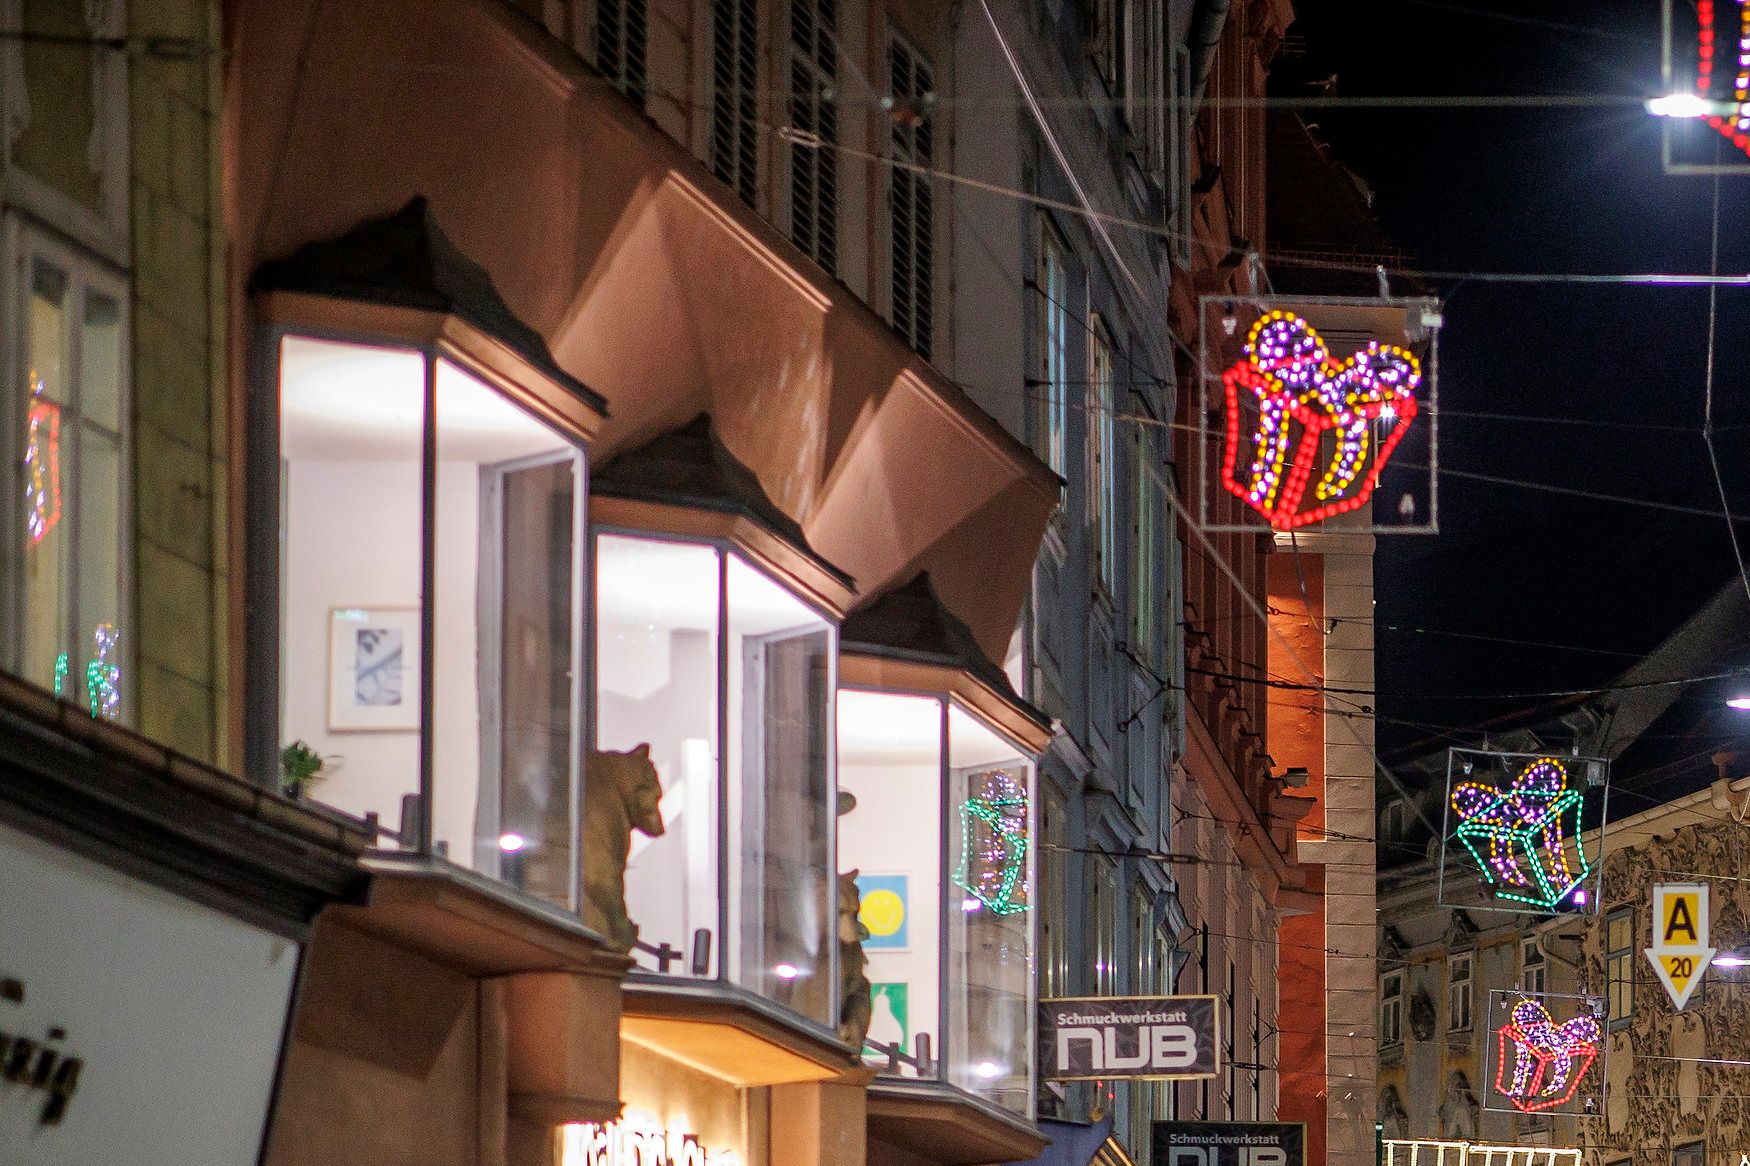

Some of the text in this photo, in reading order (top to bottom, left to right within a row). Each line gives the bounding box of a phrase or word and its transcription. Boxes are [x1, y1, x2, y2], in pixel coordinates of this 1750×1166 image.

[1664, 897, 1698, 941] A
[1670, 957, 1693, 979] 20
[1057, 1011, 1188, 1026] Schmuckwerkstatt
[1169, 1133, 1280, 1145] Schmuckwerkstatt
